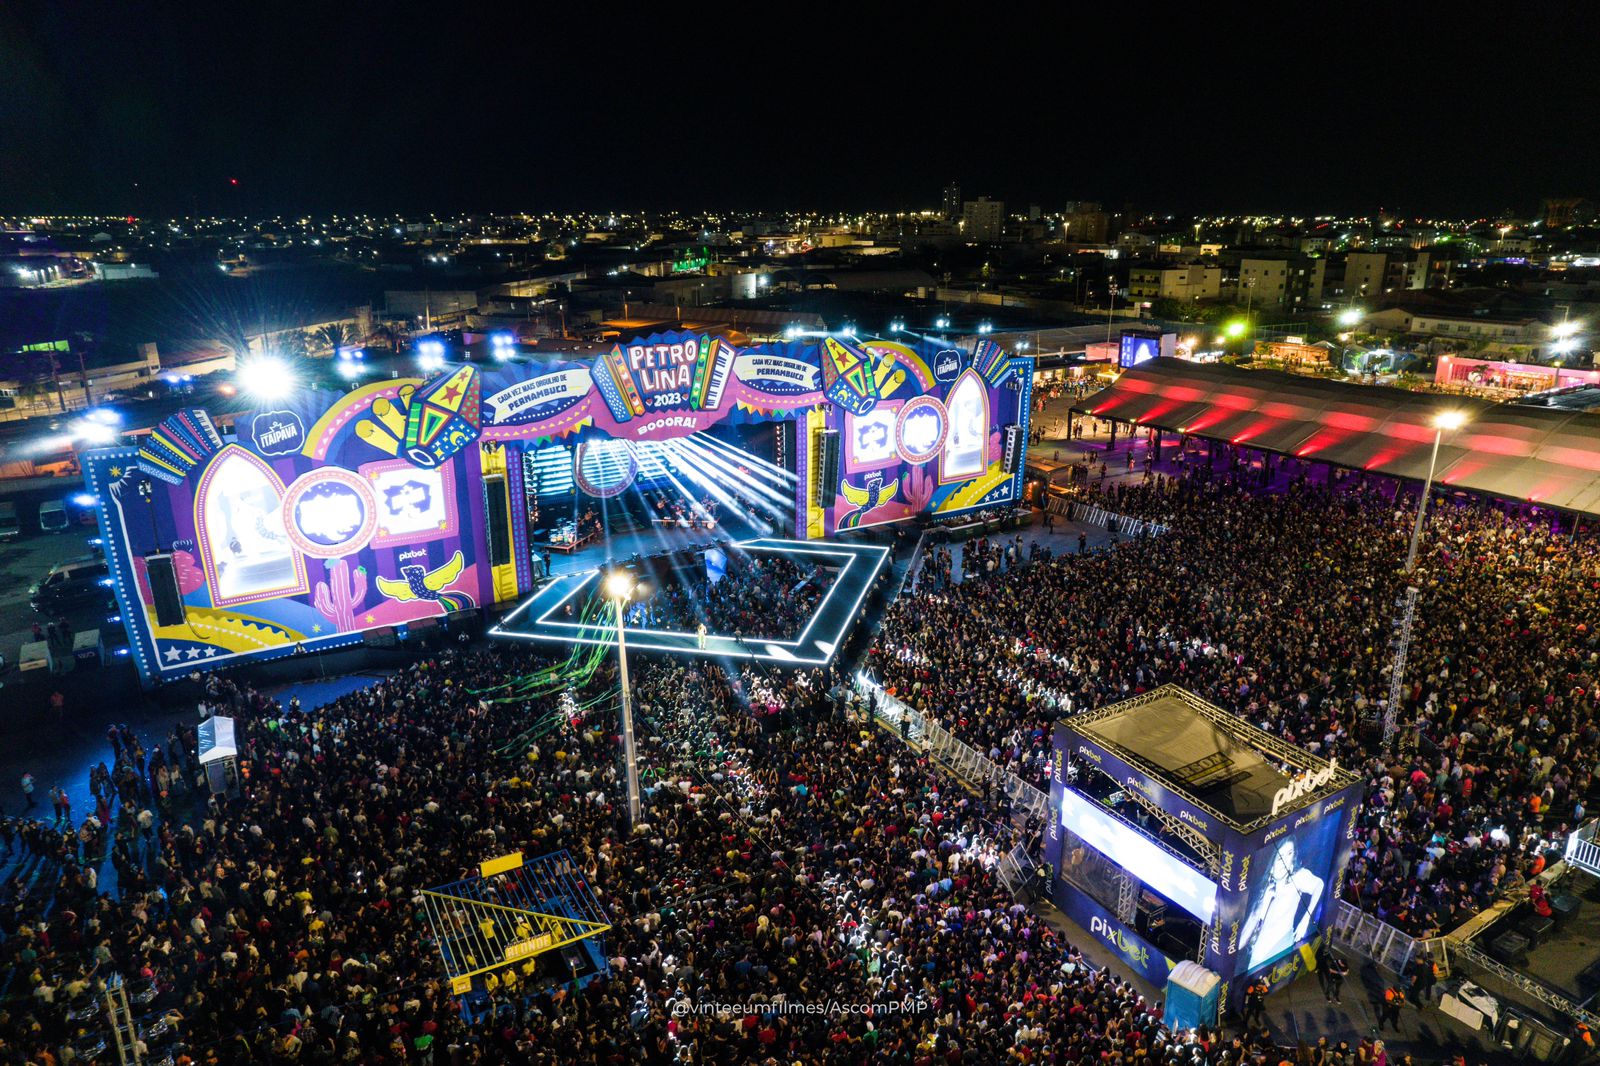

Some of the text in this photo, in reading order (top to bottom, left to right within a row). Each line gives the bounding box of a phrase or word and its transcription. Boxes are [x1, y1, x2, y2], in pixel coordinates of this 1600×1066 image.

[628, 339, 698, 371] PETRO
[640, 364, 691, 391] LINA
[756, 368, 804, 380] PERNAMBUCO
[497, 393, 512, 404] CADA
[512, 388, 522, 397] VEZ
[522, 383, 536, 394] MAIS
[536, 375, 560, 388] ORGULHO
[508, 384, 567, 411] PERNAMBUCO
[654, 392, 682, 407] 2023
[260, 425, 298, 448] ITAIPAVA
[637, 416, 697, 436] BOOORA!
[1090, 916, 1150, 969] pixbet
